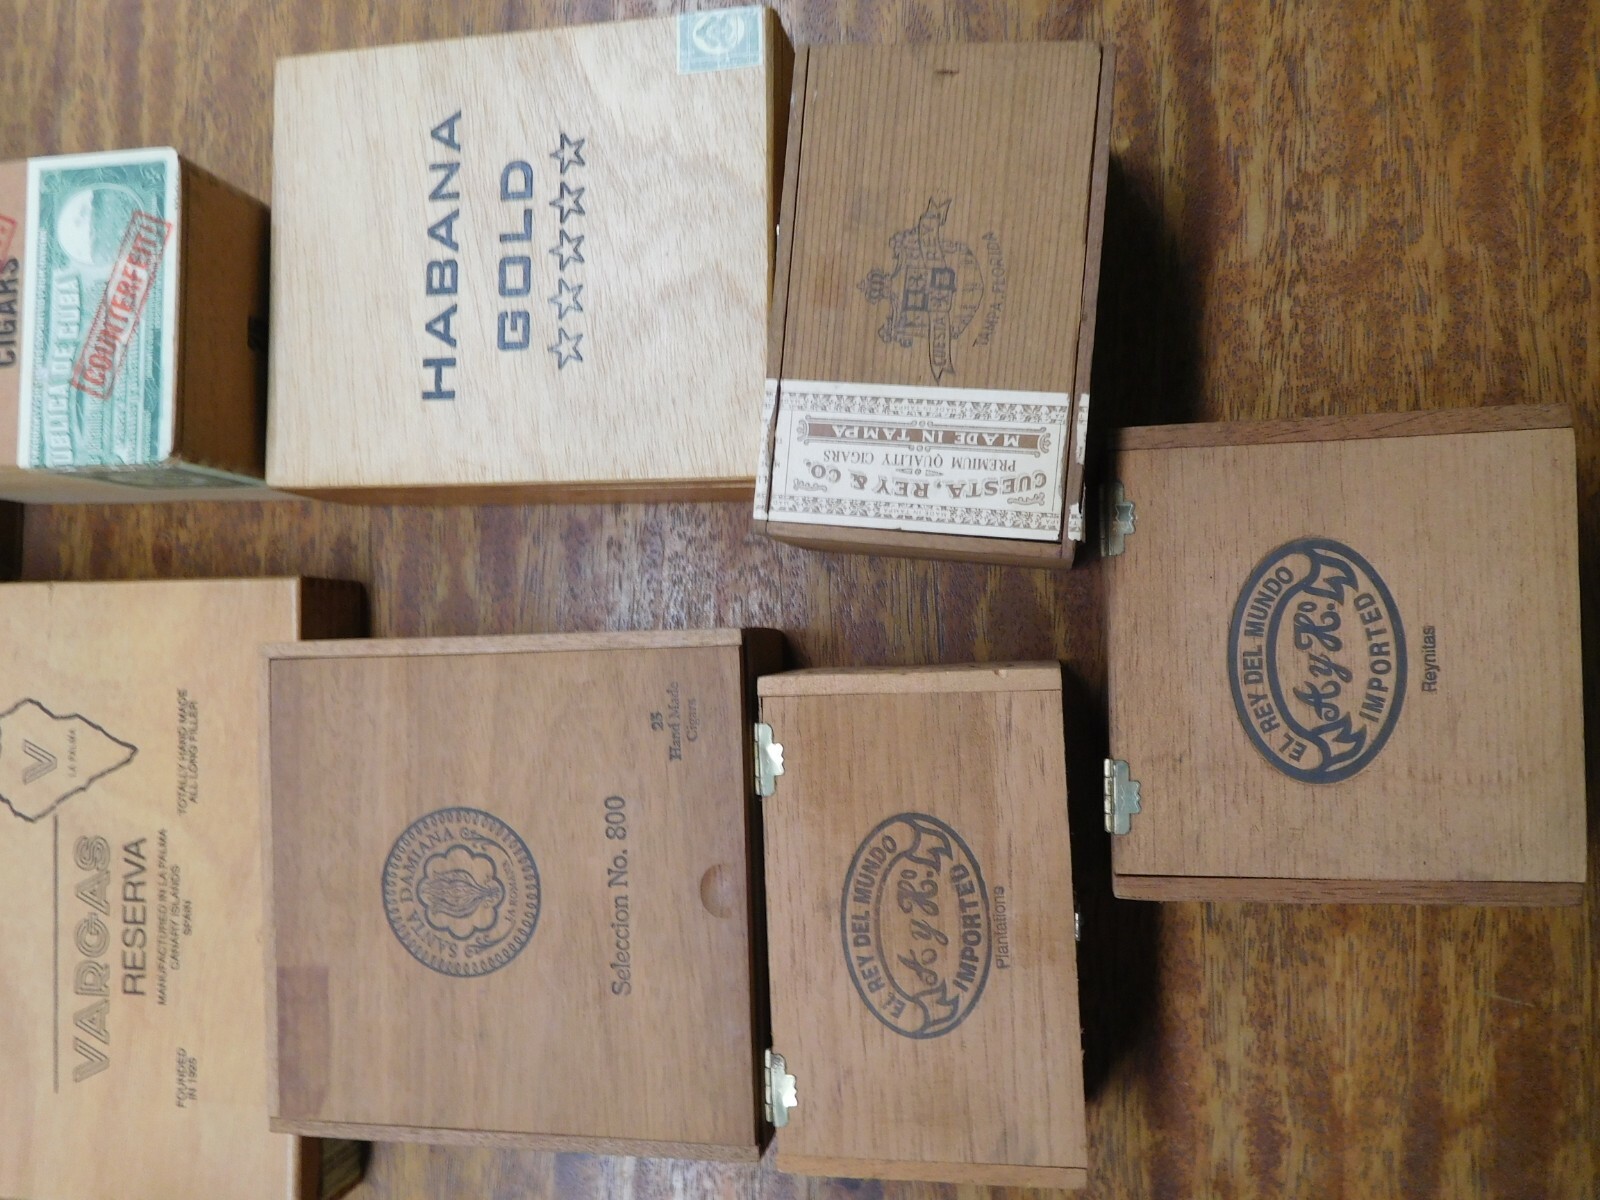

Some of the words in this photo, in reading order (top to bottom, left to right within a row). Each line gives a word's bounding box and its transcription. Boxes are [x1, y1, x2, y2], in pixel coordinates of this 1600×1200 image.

[422, 110, 462, 401] HABANA
[497, 160, 533, 351] GOLD
[921, 223, 939, 261] REY
[982, 232, 1005, 293] FLORIDA
[0, 257, 19, 369] CIGARS
[54, 275, 79, 340] CUBA
[933, 317, 947, 366] CUESTA
[51, 345, 76, 378] DE
[831, 423, 909, 441] TAMPA
[920, 430, 944, 443] IN
[954, 431, 1021, 447] MADE
[804, 458, 842, 484] CO.
[823, 450, 874, 464] CIGARS
[882, 451, 943, 468] QUALITY
[951, 456, 1017, 472] PREMIUM
[850, 473, 868, 490] &
[876, 477, 930, 498] REY
[1244, 566, 1294, 637] MUNDO
[1243, 644, 1263, 685] DEL
[1308, 654, 1352, 683] y
[1353, 592, 1391, 723] IMPORTED
[1421, 625, 1440, 692] Reynitas
[177, 688, 187, 723] MADE
[667, 682, 681, 720] Made
[686, 698, 700, 742] Cigars
[1248, 693, 1281, 734] REY
[188, 700, 198, 742] FILLER
[650, 711, 663, 731] 25
[67, 729, 77, 762] PALMA
[177, 726, 187, 761] HAND
[188, 744, 198, 779] LONG
[668, 723, 682, 761] Hand
[1278, 733, 1307, 762] EL
[67, 766, 77, 778] LA
[177, 765, 187, 815] TOTALLY
[188, 782, 198, 804] ALL
[603, 794, 627, 841] 800
[157, 828, 168, 869] PALMA
[401, 827, 453, 903] DAMIANA
[157, 872, 168, 886] LA
[607, 849, 629, 888] No.
[853, 835, 897, 904] MUNDO
[157, 889, 168, 902] IN
[170, 864, 180, 917] ISLANDS
[121, 837, 147, 997] RESERVA
[182, 899, 192, 936] SPAIN
[407, 910, 458, 958] SANTA
[851, 910, 871, 948] DEL
[910, 919, 948, 946] y
[950, 864, 982, 992] IMPORTED
[992, 885, 1010, 970] Plantations
[72, 834, 111, 1083] VARGAS
[157, 905, 168, 1006] MANUFACTURED
[170, 920, 180, 971] CANARY
[610, 895, 632, 996] Seleccion
[856, 954, 886, 994] REY
[882, 992, 906, 1019] EL
[176, 1047, 187, 1109] FOUNDED
[188, 1087, 197, 1100] IN
